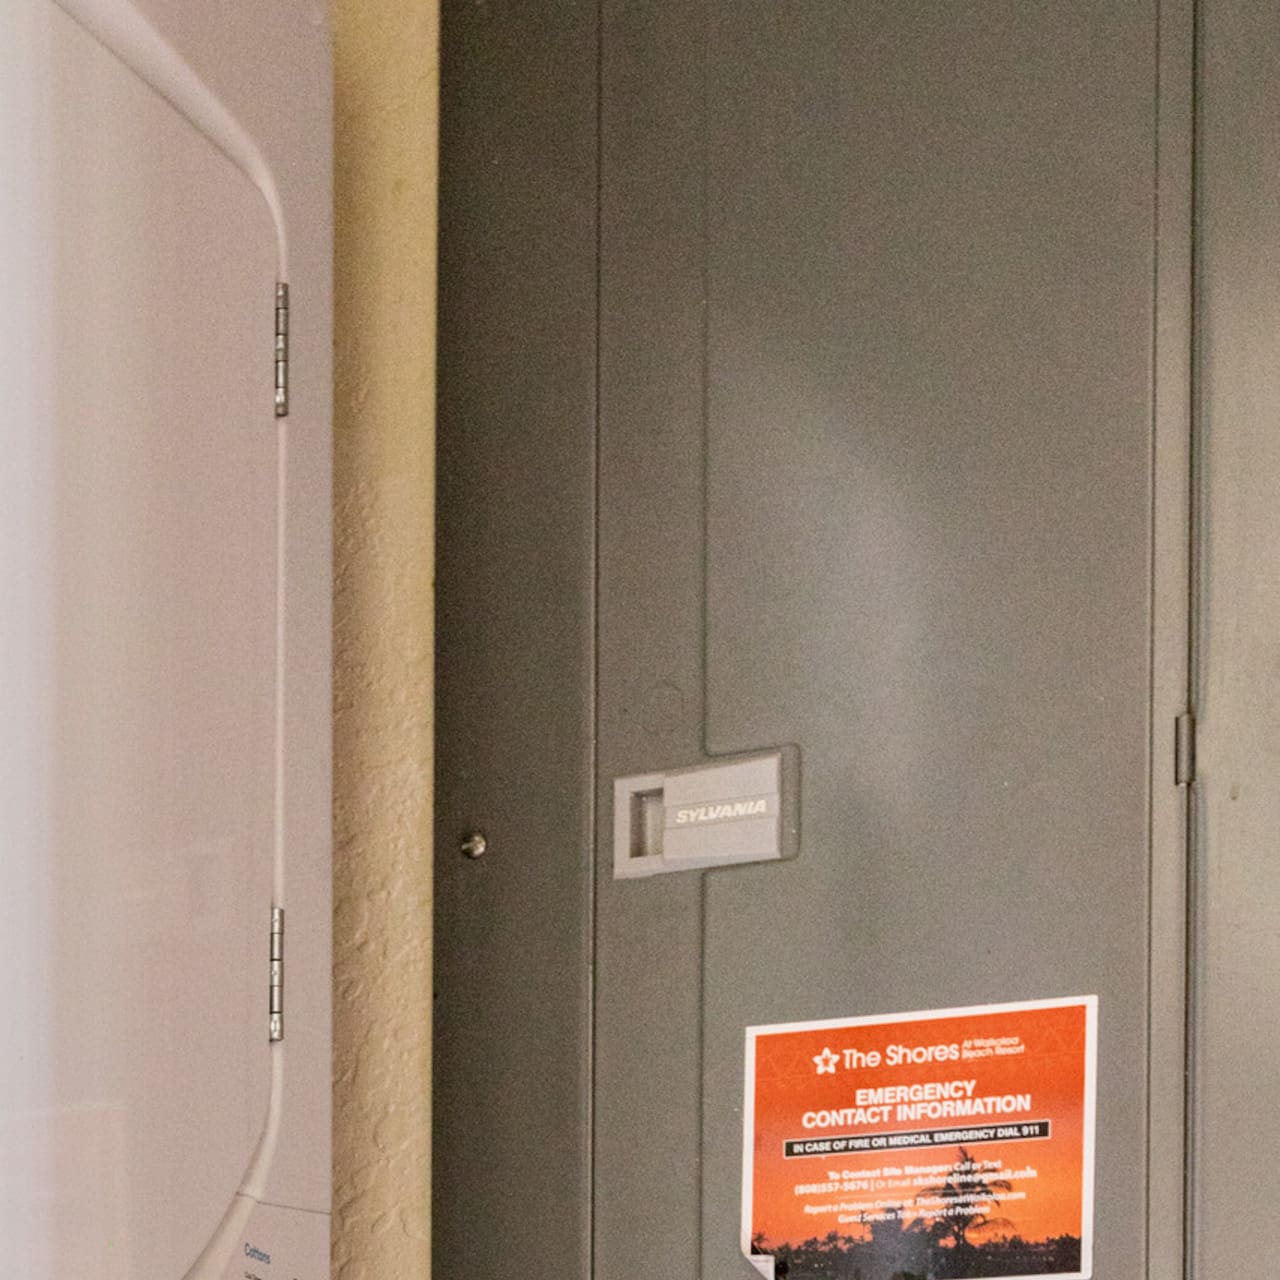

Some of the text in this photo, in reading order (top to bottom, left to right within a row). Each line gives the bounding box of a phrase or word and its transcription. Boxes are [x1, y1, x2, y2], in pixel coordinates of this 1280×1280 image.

[676, 799, 767, 823] SYLVANIA
[843, 1044, 960, 1069] The Shores
[962, 1044, 1024, 1059] Beach Resort
[855, 1080, 976, 1105] EMERGENCY
[802, 1094, 1031, 1129] CONTACT INFORMATION
[793, 1125, 1040, 1154] IN CASE OF FIRE OR MEDICAL EMERGENCY DIAL 911
[842, 1168, 881, 1179] Contact
[953, 1161, 970, 1171] Call
[983, 1160, 1002, 1169] Text
[245, 1242, 271, 1265] Cottons
